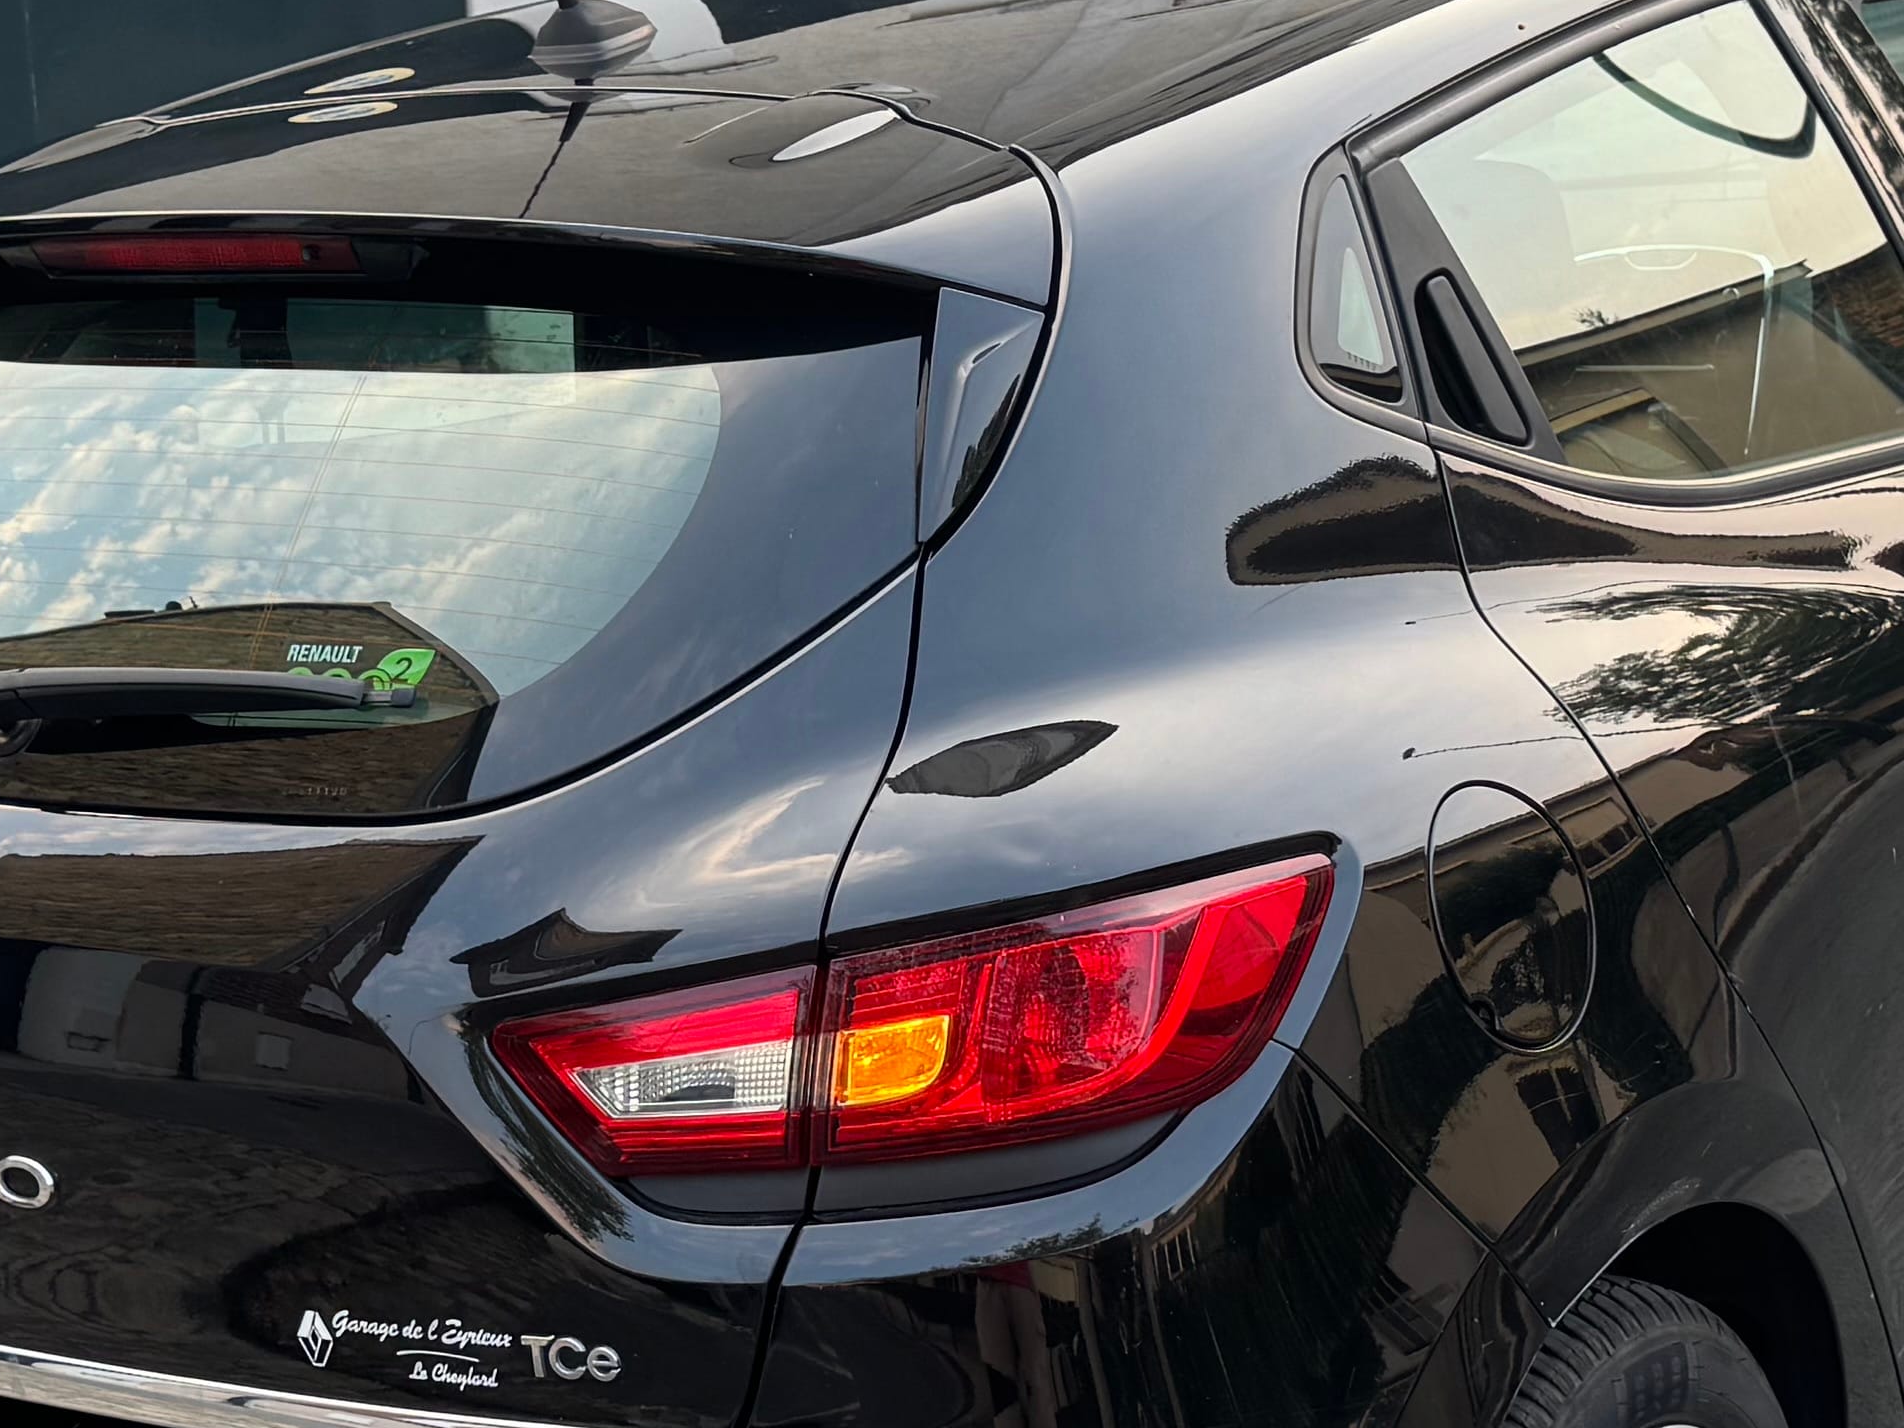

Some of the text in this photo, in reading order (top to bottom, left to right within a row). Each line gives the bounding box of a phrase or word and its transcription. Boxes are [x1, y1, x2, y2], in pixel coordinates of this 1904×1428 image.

[286, 644, 363, 663] RENAULT
[332, 1309, 400, 1345] Garage
[402, 1319, 423, 1340] de
[441, 1319, 513, 1349] Eyrieux
[521, 1334, 622, 1382] TCe
[409, 1361, 499, 1391] Le Cheylard
